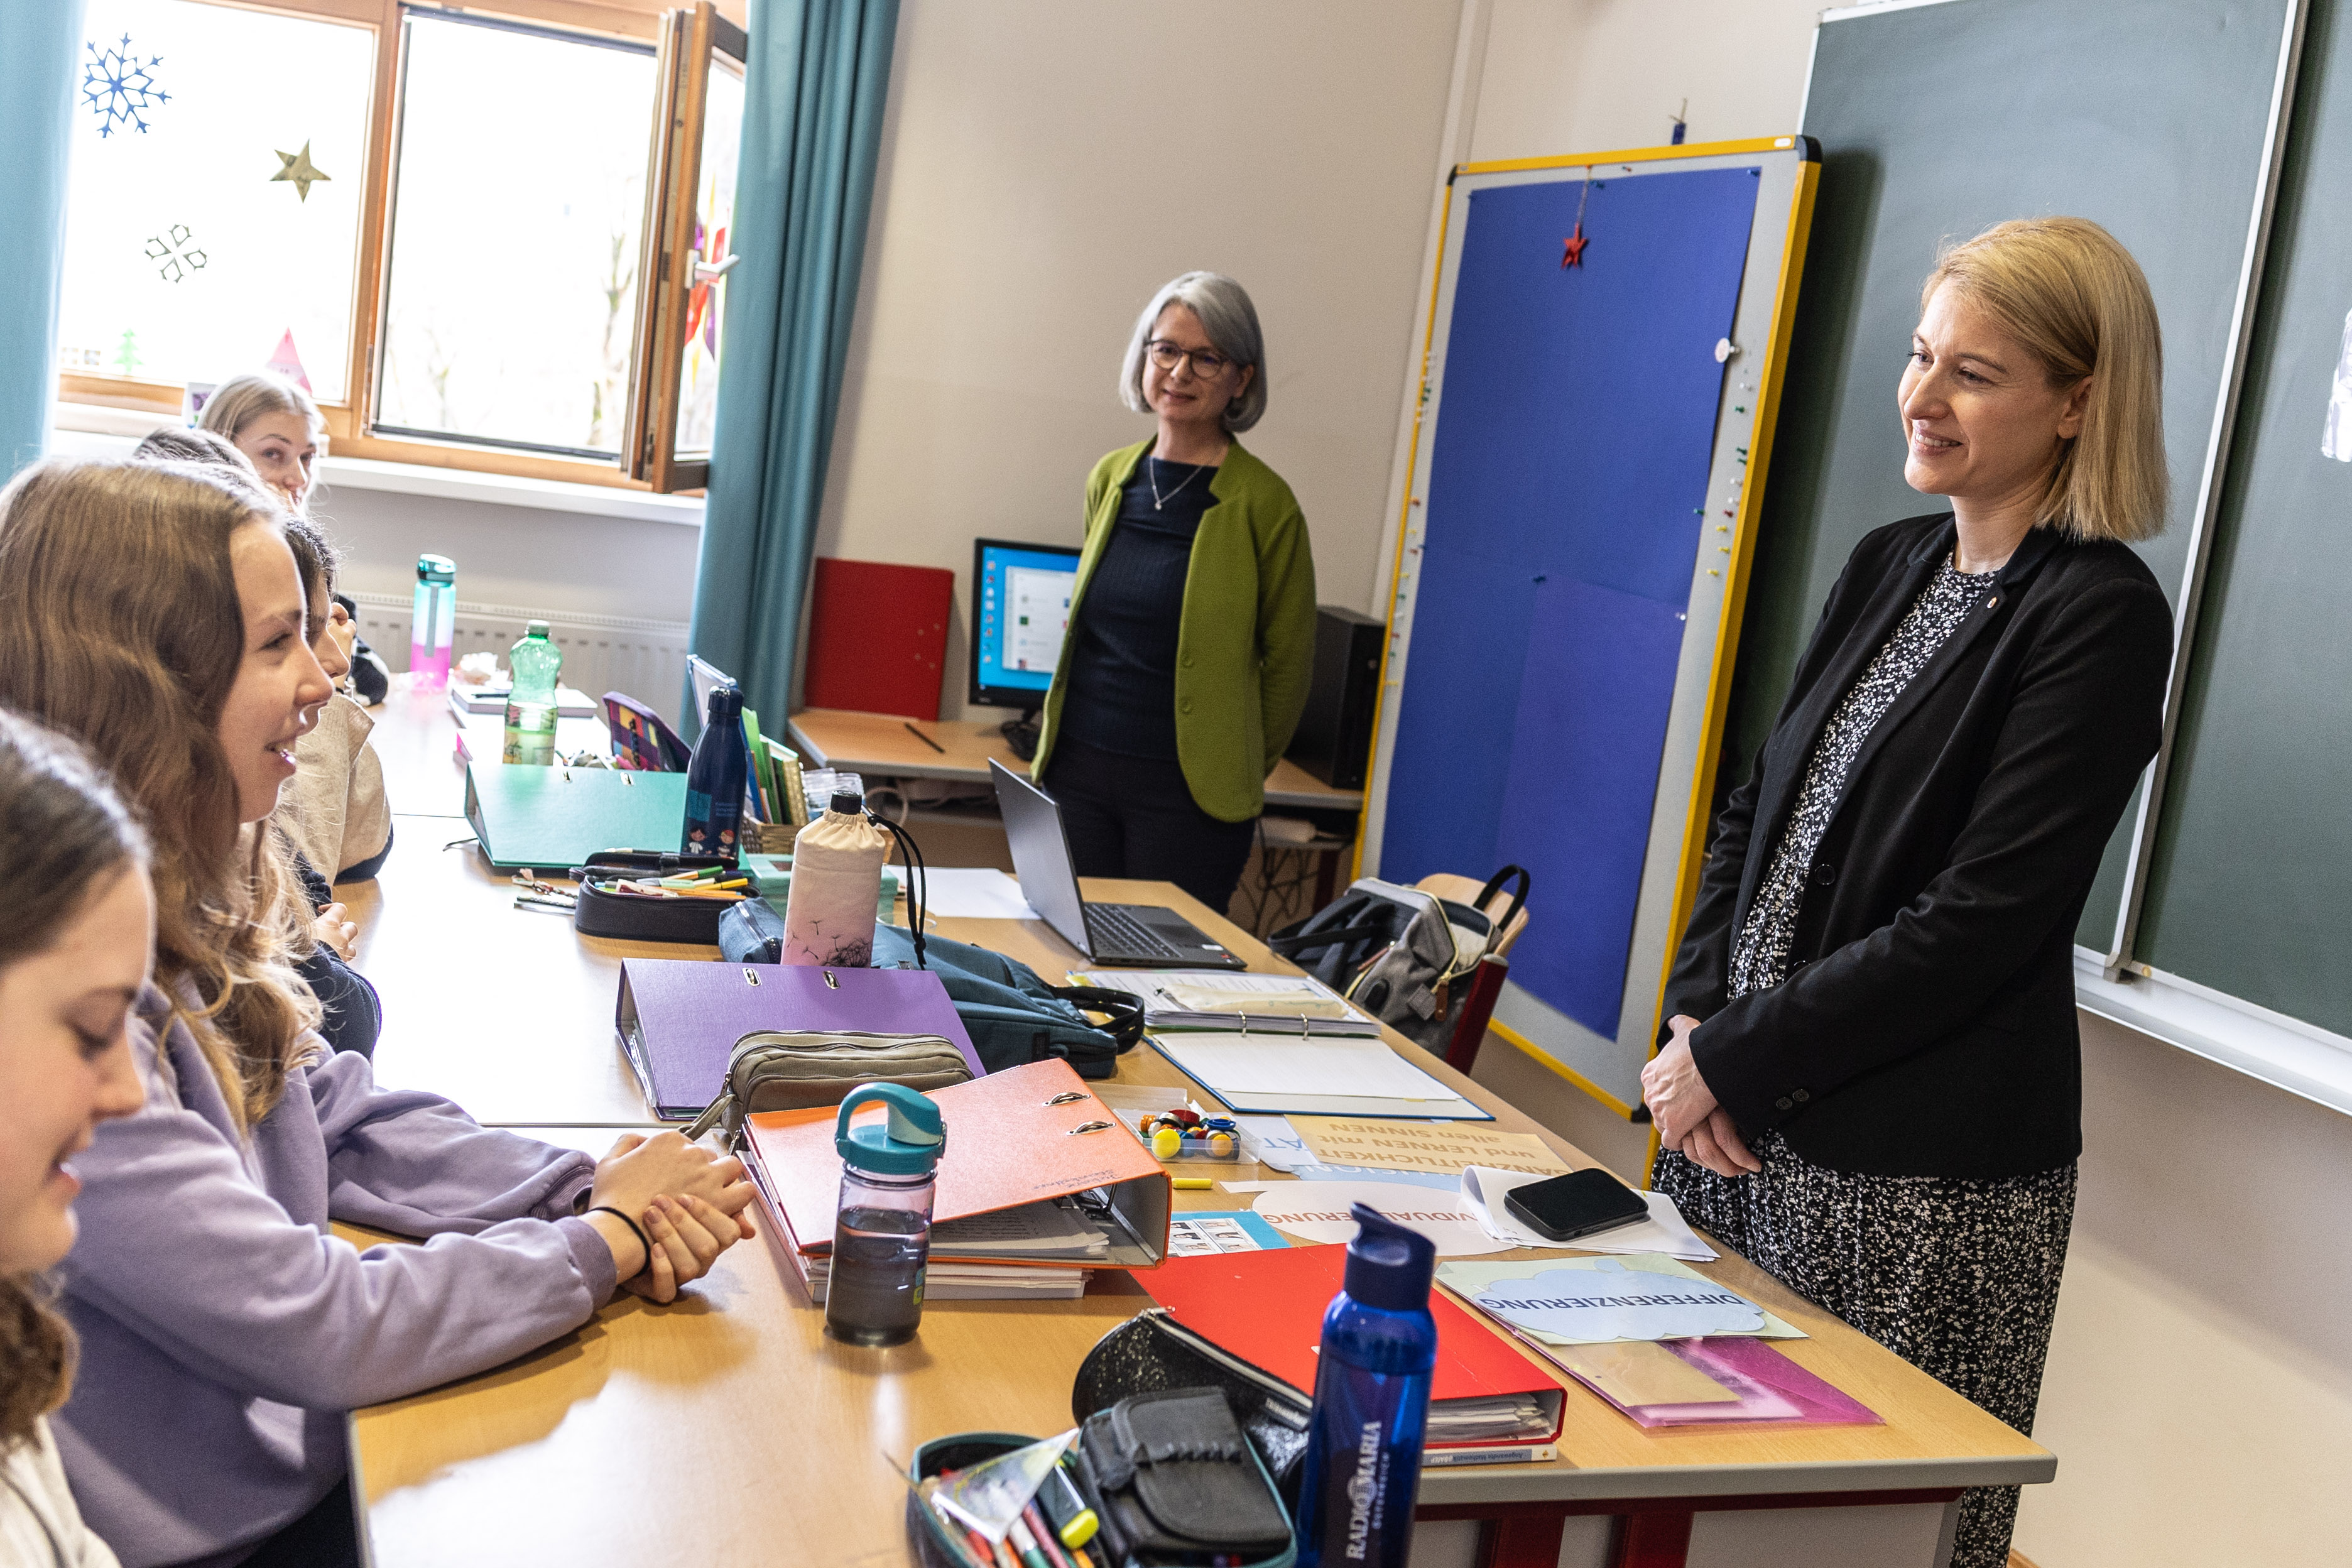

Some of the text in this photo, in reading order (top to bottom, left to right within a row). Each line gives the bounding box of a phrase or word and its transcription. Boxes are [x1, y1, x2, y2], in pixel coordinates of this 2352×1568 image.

[1329, 1123, 1501, 1144] allen SINNEN
[1317, 1135, 1535, 1158] und LERNEN mit
[1481, 1294, 1745, 1310] DIFFERENZIERUNG
[1358, 1421, 1382, 1486] MARIA
